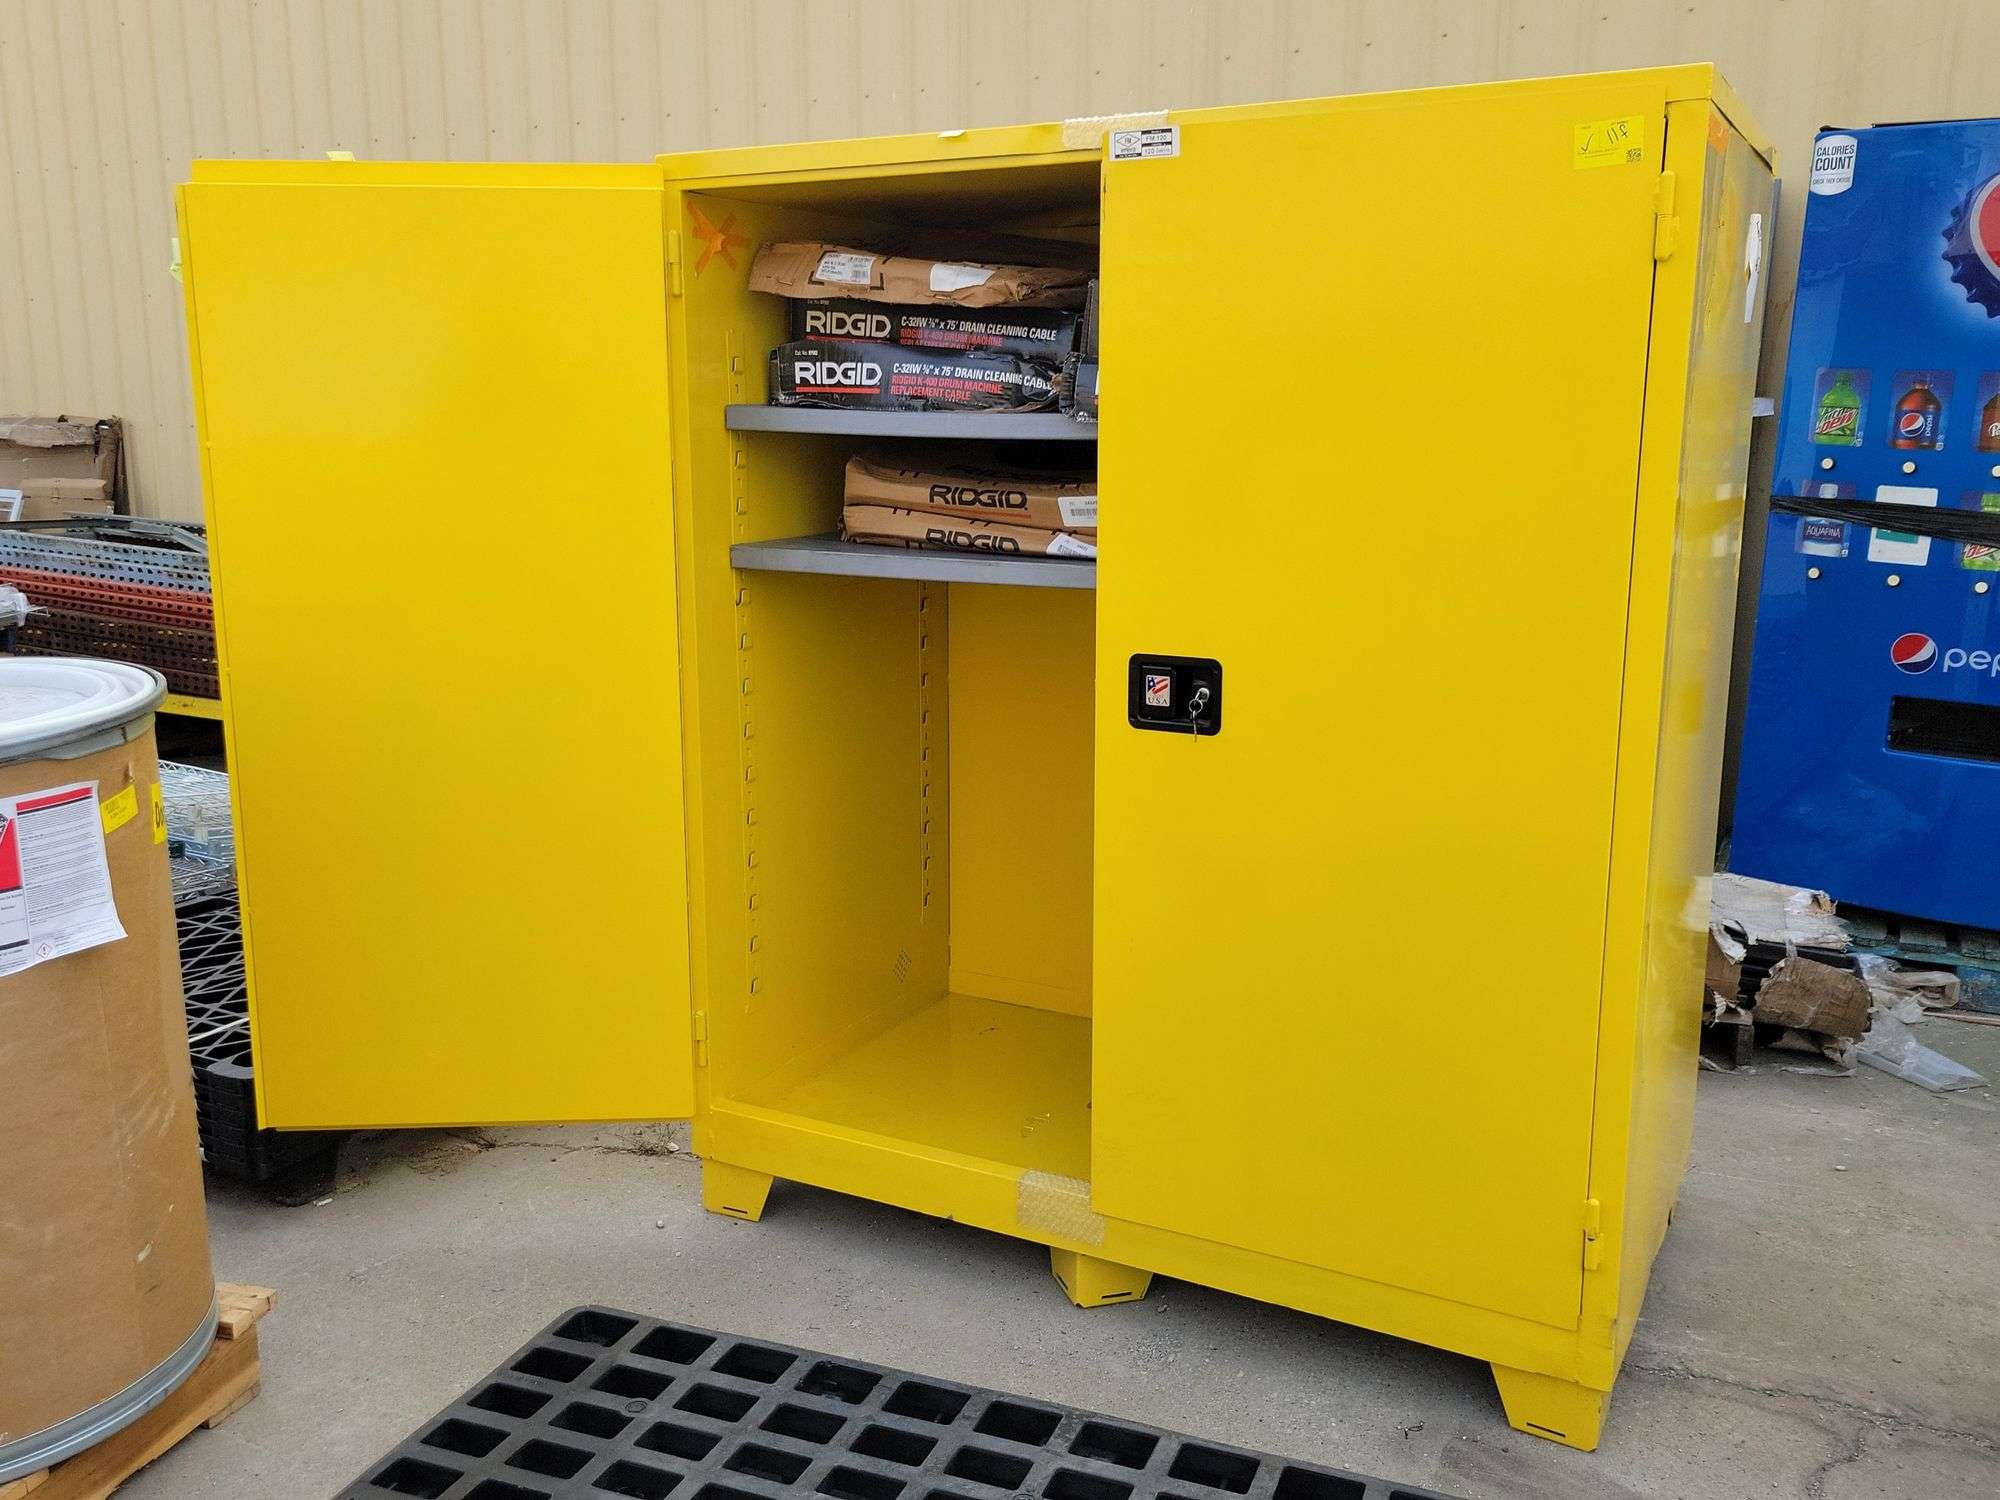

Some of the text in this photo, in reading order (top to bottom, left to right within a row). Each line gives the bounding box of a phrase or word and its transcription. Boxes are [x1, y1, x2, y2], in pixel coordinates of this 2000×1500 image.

[1816, 144, 1855, 157] CALORIES
[1815, 156, 1853, 171] COUNT
[806, 311, 891, 338] RIDGID
[960, 321, 986, 333] DRAIN
[987, 323, 1028, 338] CLEANING
[1029, 327, 1057, 340] CABLE
[795, 362, 882, 386] RIDGID
[933, 367, 940, 376] x
[954, 367, 983, 380] DRAIN
[891, 385, 971, 401] REPLACEMENT CABLE
[963, 380, 1004, 394] MACHINE
[929, 484, 1028, 511] RIDGID
[1804, 525, 1841, 537] AQUAFINA
[925, 528, 1020, 552] RIDGID
